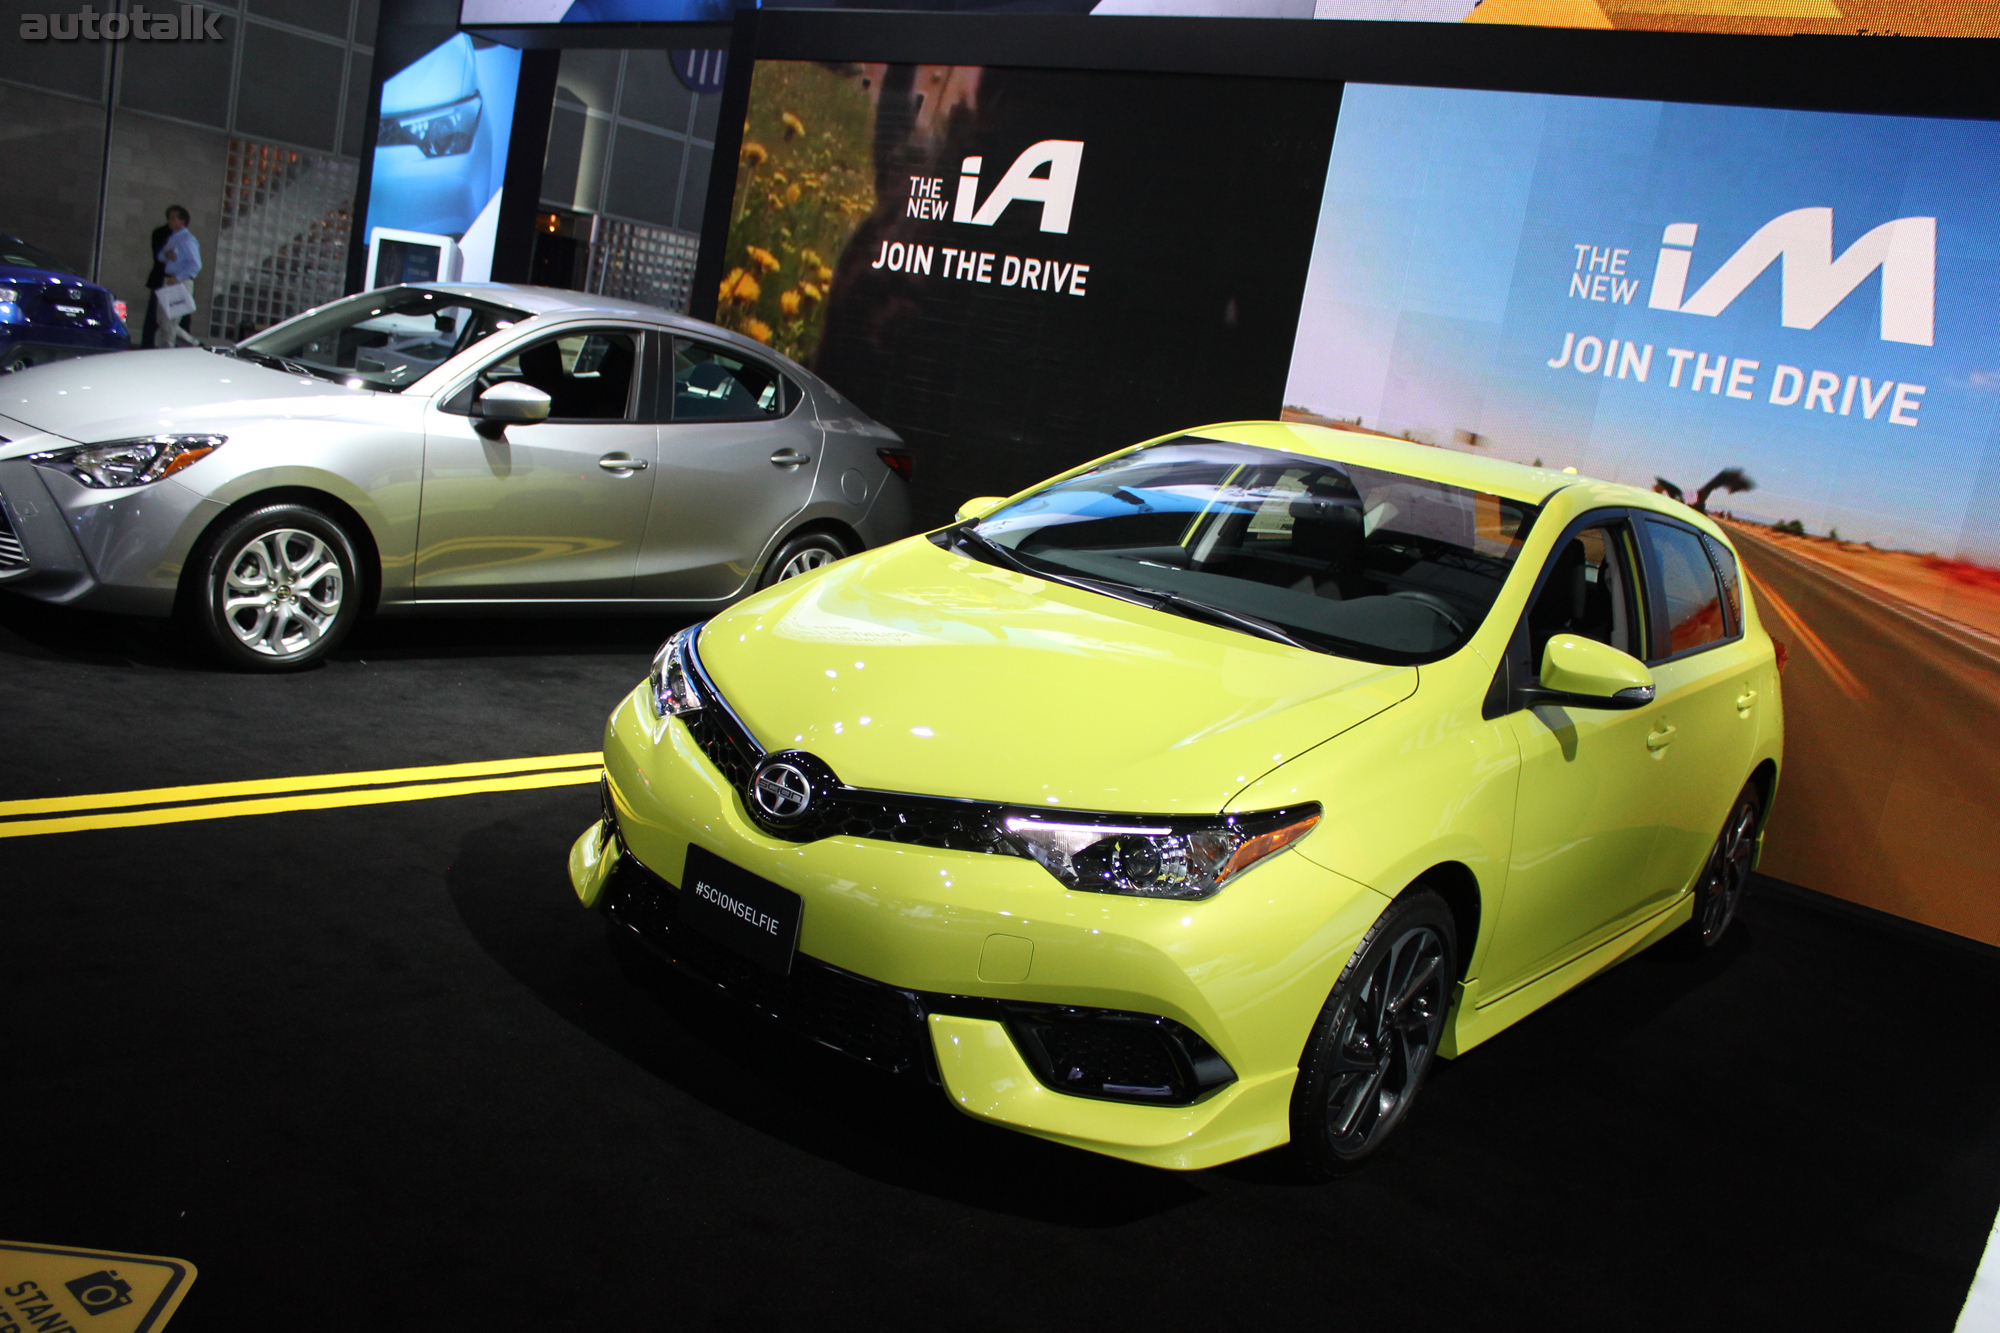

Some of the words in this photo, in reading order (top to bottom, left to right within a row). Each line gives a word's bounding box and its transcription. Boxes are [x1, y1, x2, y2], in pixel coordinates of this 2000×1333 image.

[906, 197, 949, 221] NEW
[910, 176, 943, 199] THE
[953, 139, 1084, 234] iA
[872, 240, 934, 275] JOIN
[942, 248, 995, 283] THE
[1001, 255, 1090, 296] DRIVE
[1574, 244, 1630, 276] THE
[1648, 206, 1936, 347] iM
[1568, 272, 1639, 305] NEW
[1547, 332, 1653, 382] JOIN
[1667, 347, 1760, 400] THE
[1769, 364, 1927, 427] DRIVE
[695, 880, 780, 936] #SCIONSELFIE
